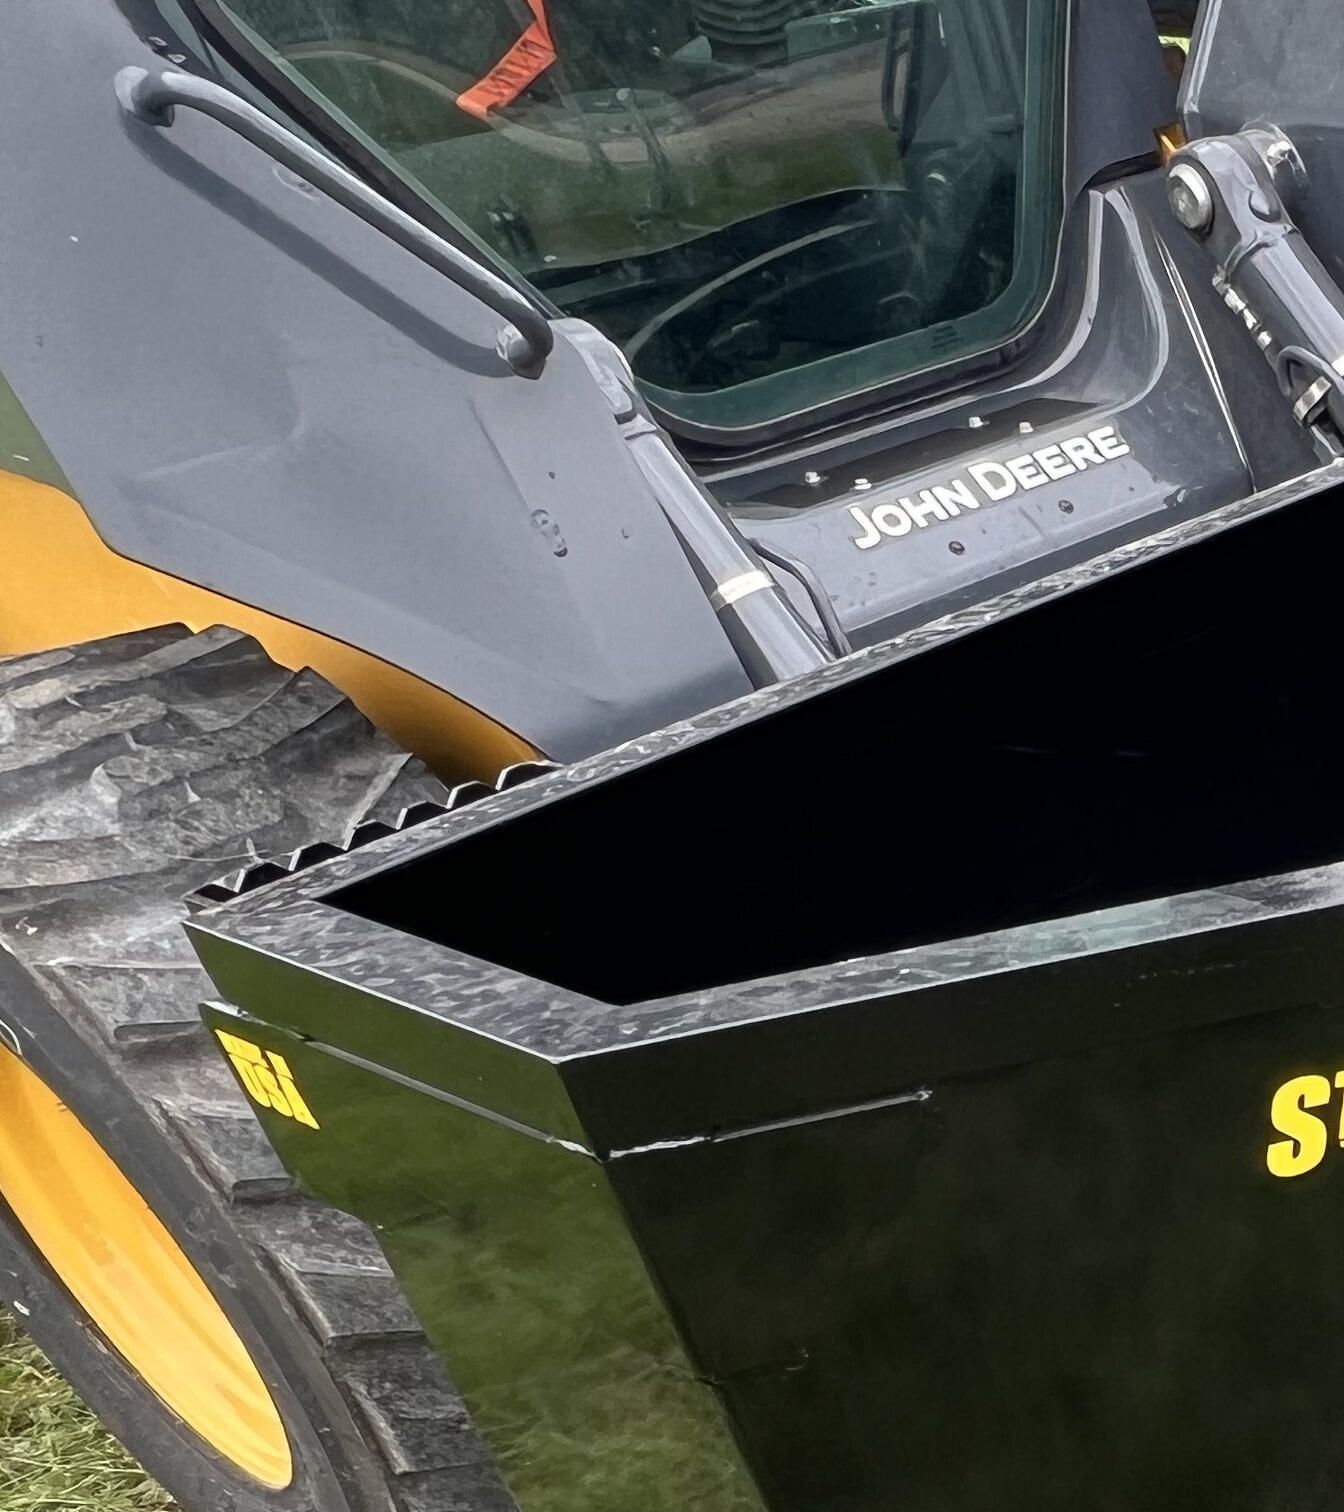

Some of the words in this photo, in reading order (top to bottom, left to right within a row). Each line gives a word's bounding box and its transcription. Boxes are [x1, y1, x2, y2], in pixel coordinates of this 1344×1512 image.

[849, 479, 981, 550] JOHN
[967, 425, 1130, 501] DEERE
[228, 1052, 321, 1130] USA
